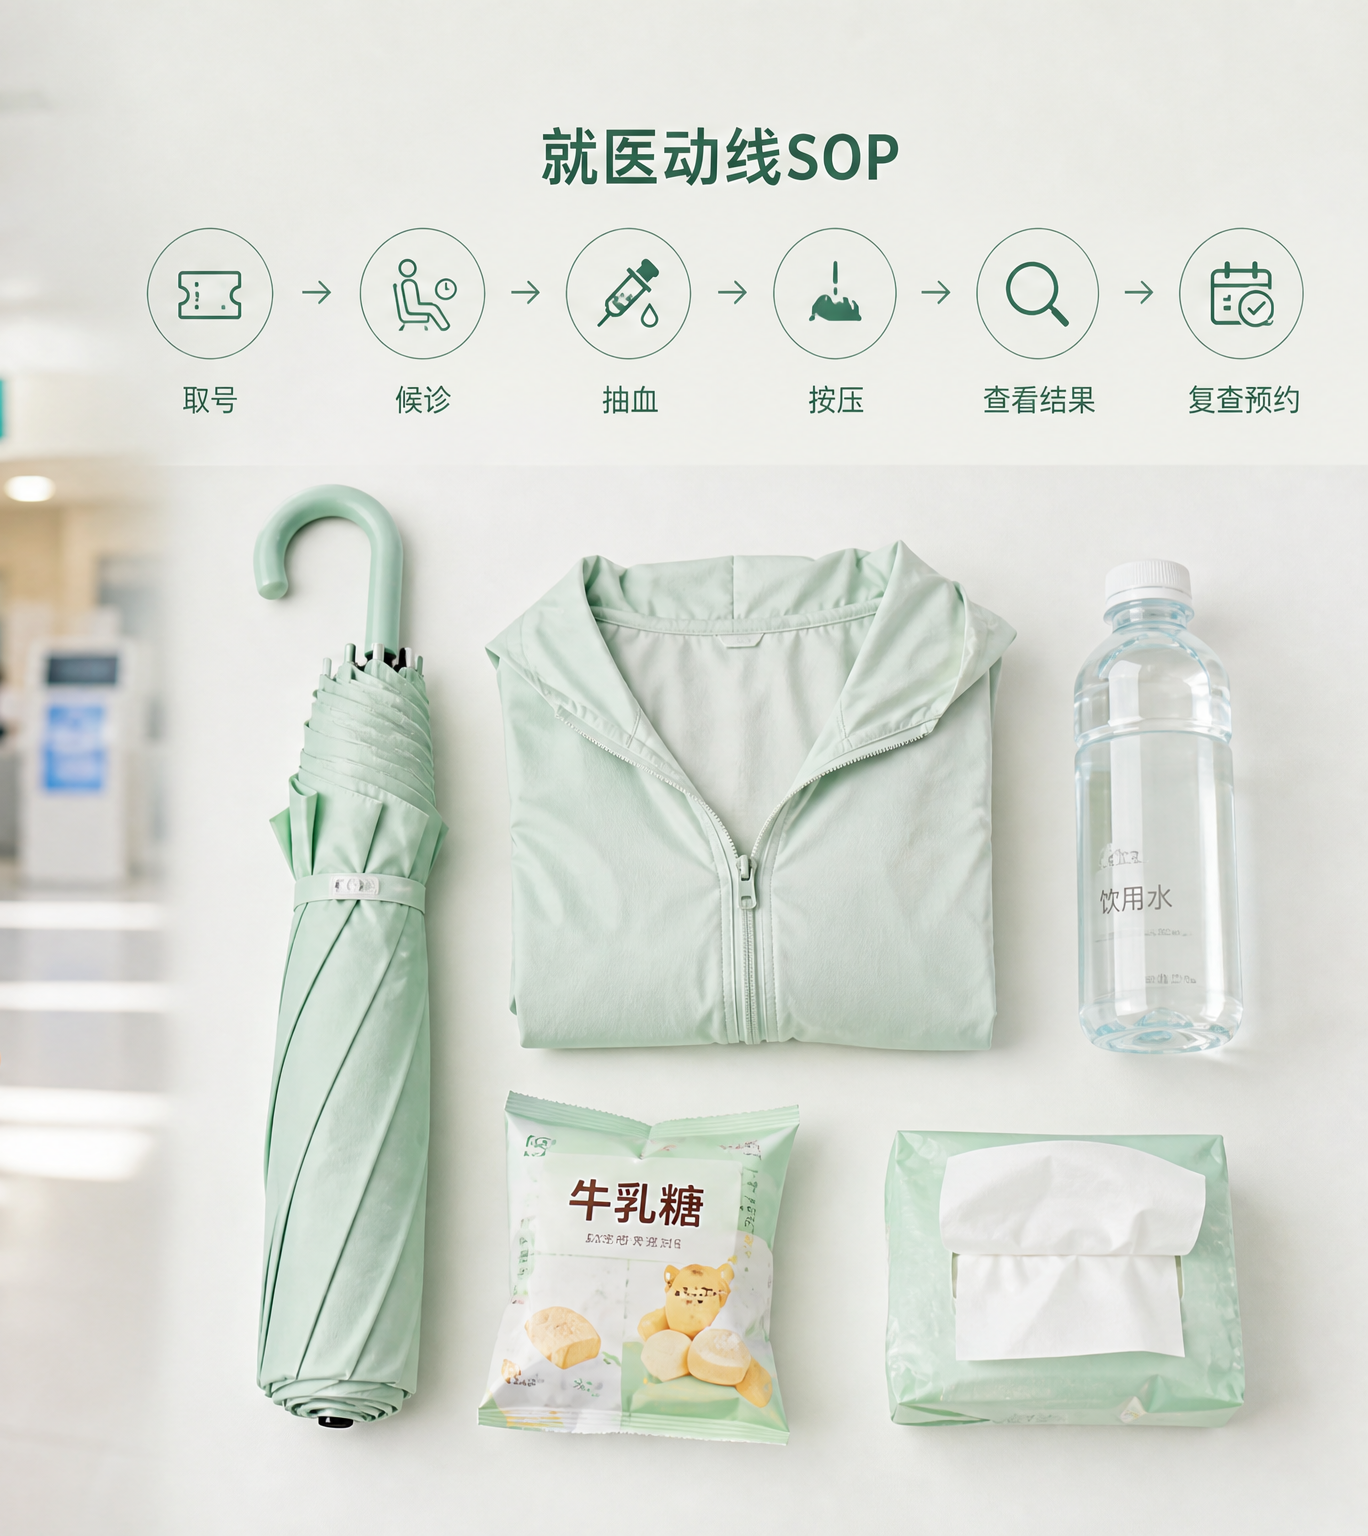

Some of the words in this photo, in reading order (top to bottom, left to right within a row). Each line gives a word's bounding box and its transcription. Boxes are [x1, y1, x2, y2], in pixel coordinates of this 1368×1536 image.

[1099, 883, 1173, 915] 饮用水
[568, 1178, 705, 1228] 牛乳糖
